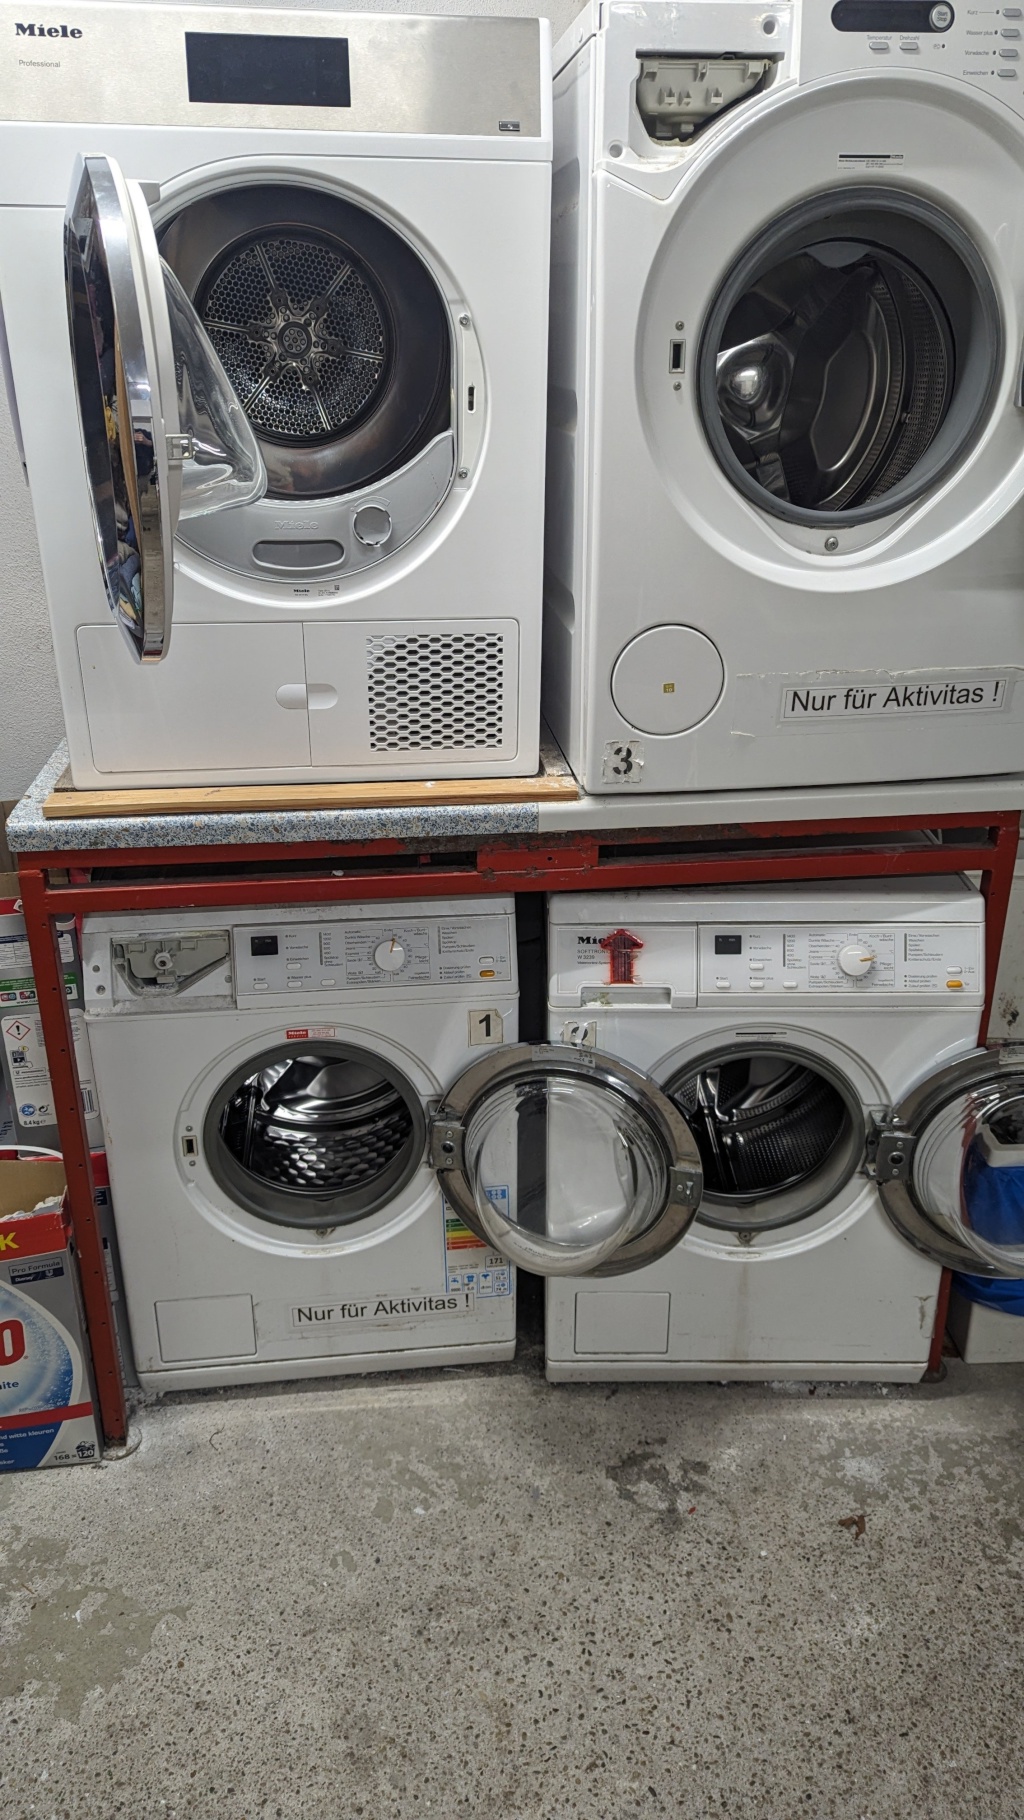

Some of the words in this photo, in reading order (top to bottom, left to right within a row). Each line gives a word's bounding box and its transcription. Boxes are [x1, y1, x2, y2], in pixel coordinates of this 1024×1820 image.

[14, 22, 83, 39] Miele
[18, 60, 61, 68] Professional
[274, 520, 319, 531] Miele
[791, 690, 836, 712] Nur
[844, 688, 877, 710] für
[882, 684, 984, 708] Aktivitas
[992, 681, 999, 702] !
[612, 746, 633, 775] 3
[478, 1014, 491, 1037] 1
[28, 1261, 60, 1271] Formula
[489, 1257, 503, 1265] 171
[297, 1307, 334, 1322] Nur
[340, 1304, 367, 1319] für
[374, 1296, 458, 1316] Aktivitas
[465, 1293, 470, 1308] !
[9, 1431, 27, 1439] witte
[28, 1428, 55, 1436] kleuren
